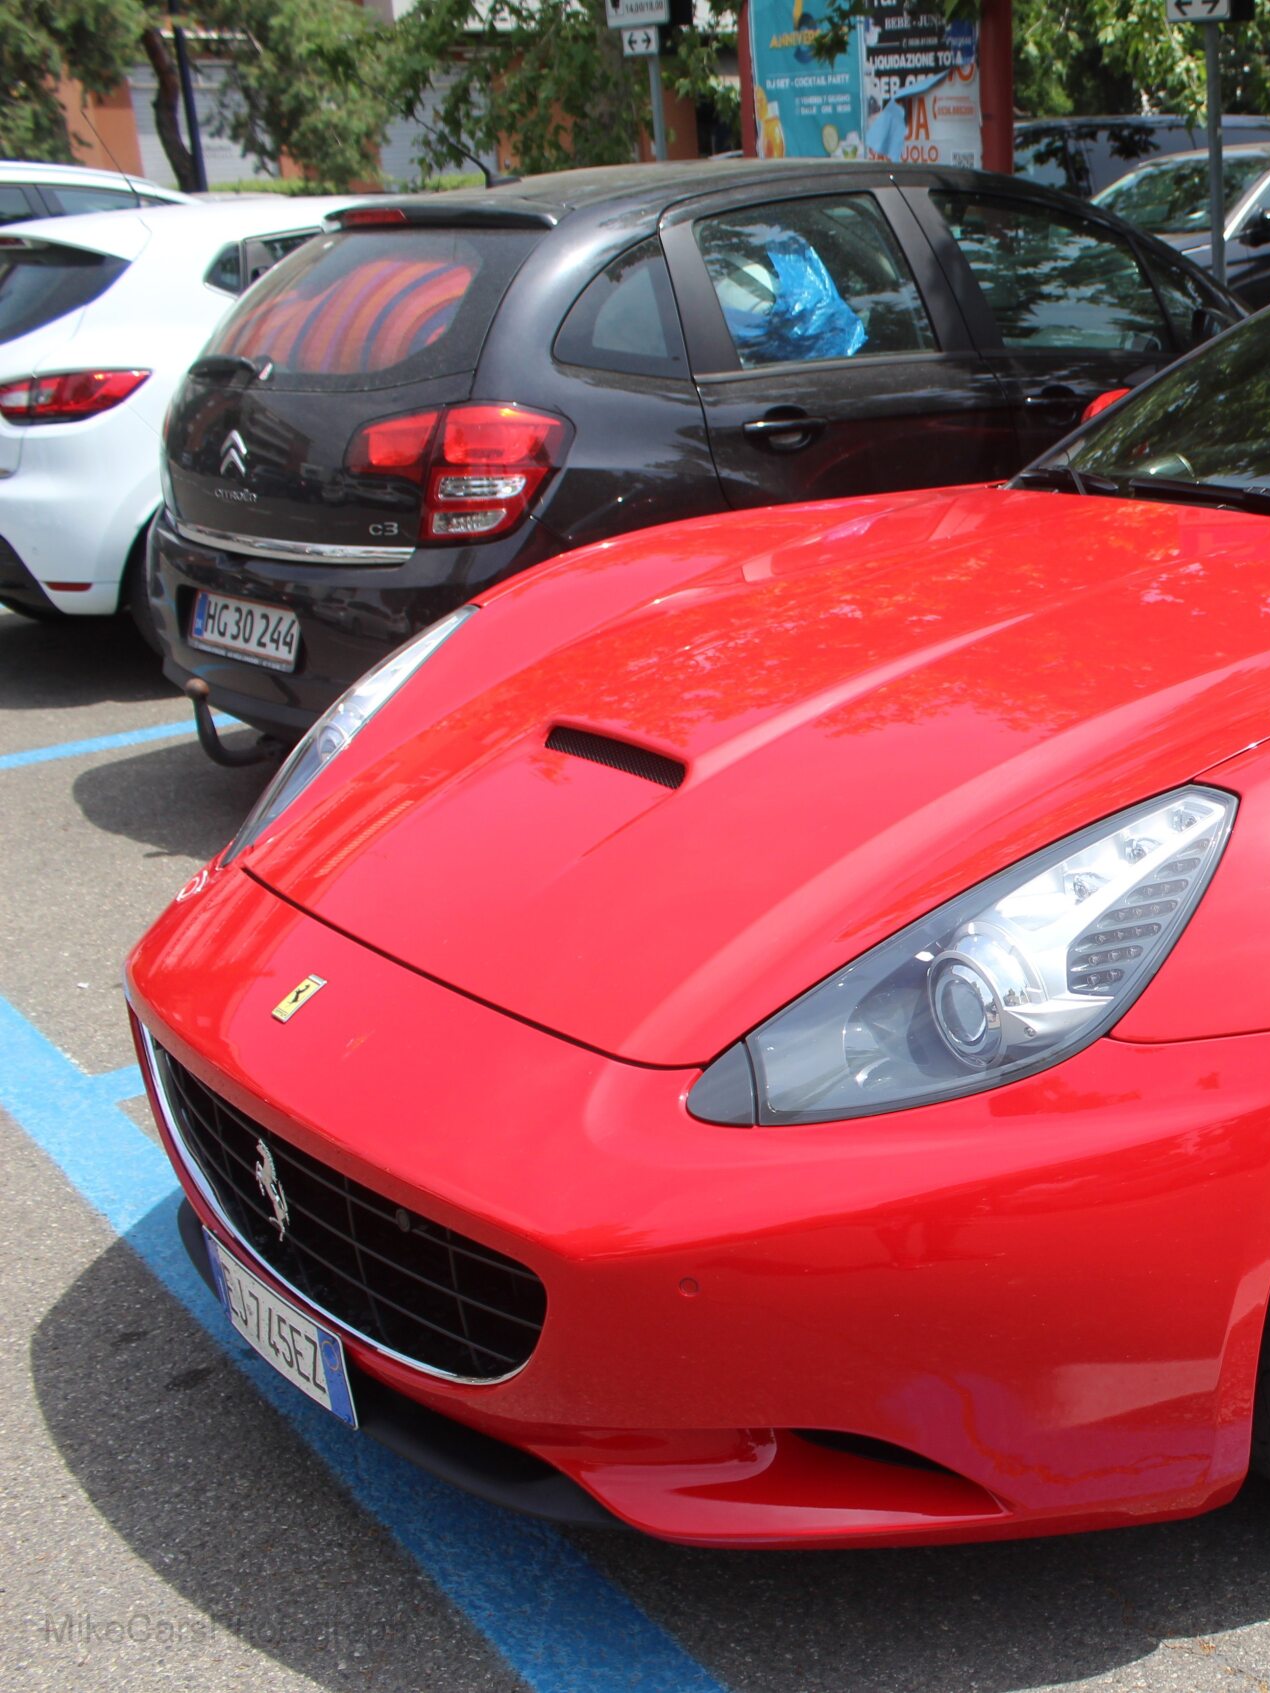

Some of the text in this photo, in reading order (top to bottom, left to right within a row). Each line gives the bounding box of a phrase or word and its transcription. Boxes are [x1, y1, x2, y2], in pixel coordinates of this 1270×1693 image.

[869, 51, 935, 70] LIQUIDAZIONE
[795, 75, 826, 88] COCKTAIL
[827, 73, 849, 86] PARTY
[205, 600, 297, 655] HG 30 244
